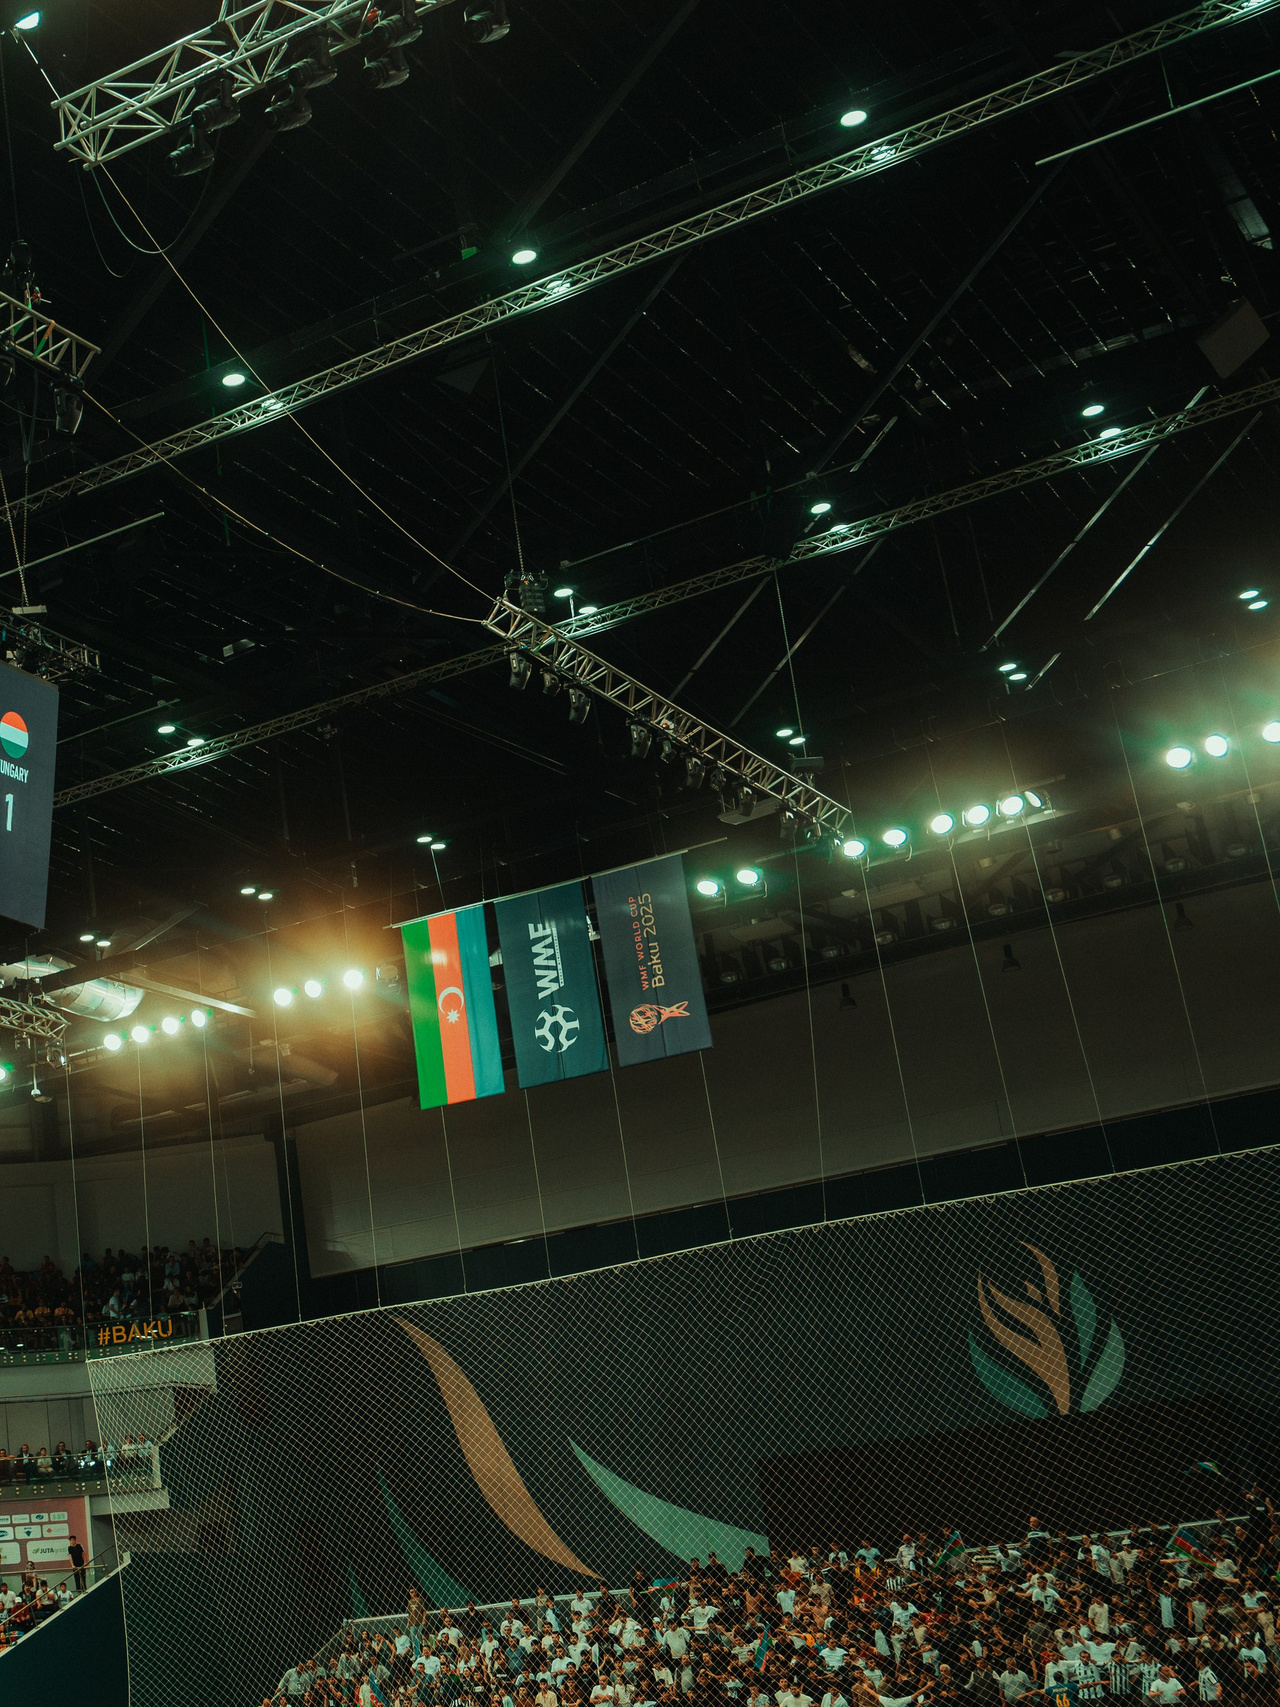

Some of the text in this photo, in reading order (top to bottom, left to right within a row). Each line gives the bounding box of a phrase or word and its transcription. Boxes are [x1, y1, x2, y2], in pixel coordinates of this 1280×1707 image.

[5, 793, 14, 832] 1
[528, 923, 560, 1000] WMF
[628, 896, 649, 991] WMF WORLD CUP
[637, 893, 665, 988] Baku 2025
[97, 1319, 173, 1346] #BAKU
